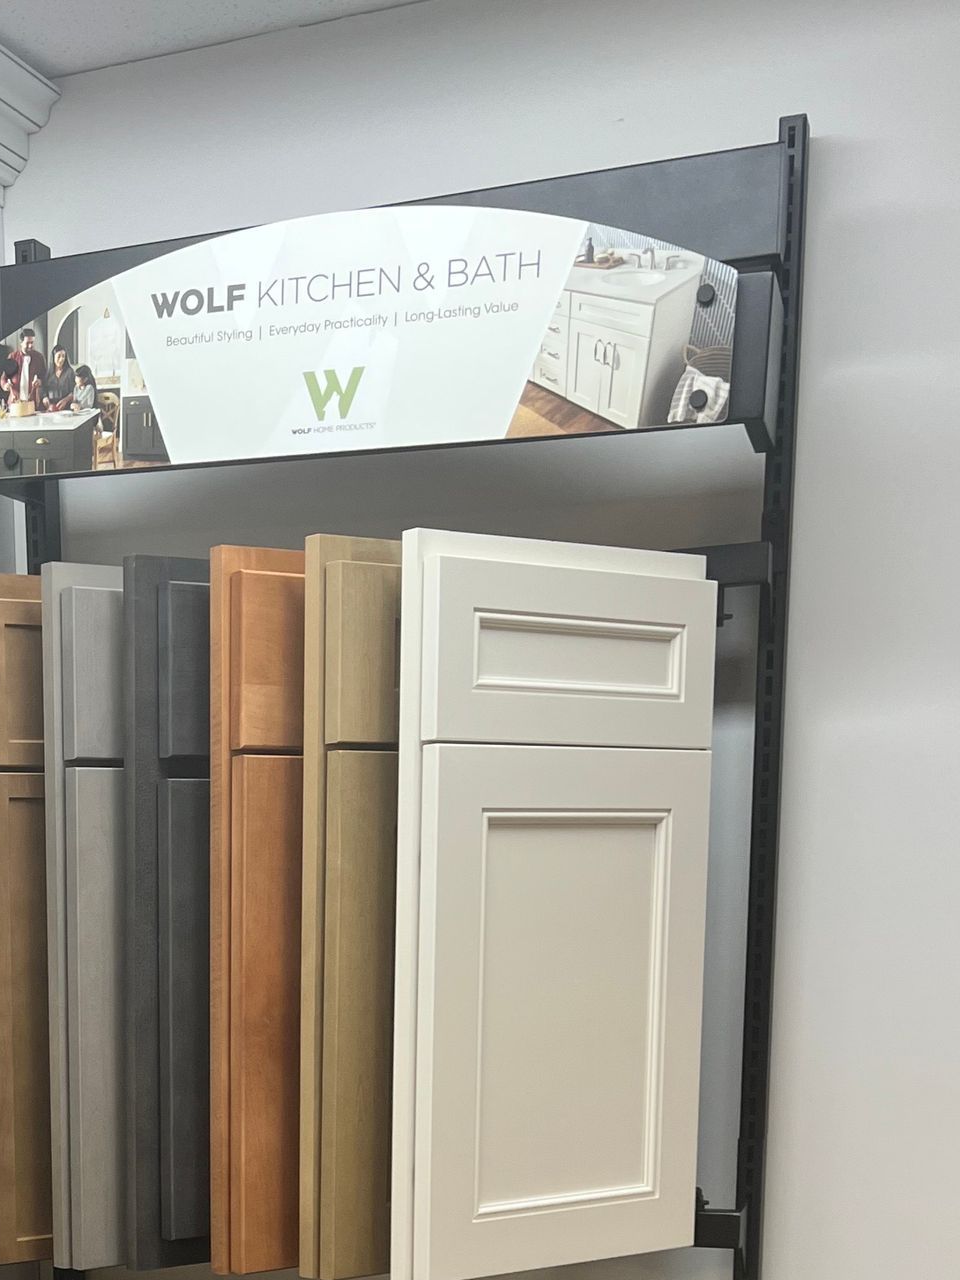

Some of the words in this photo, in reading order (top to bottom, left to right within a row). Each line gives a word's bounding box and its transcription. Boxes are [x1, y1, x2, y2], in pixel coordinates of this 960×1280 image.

[151, 284, 246, 319] WOLF
[258, 265, 401, 308] KITCHEN
[413, 262, 435, 291] &
[447, 250, 541, 288] BATH
[166, 331, 214, 347] Beautiful
[216, 328, 253, 342] Styling
[269, 321, 321, 338] Everyday
[324, 314, 388, 331] Practicality
[405, 304, 481, 323] Long-Lasting
[484, 301, 519, 315] Value
[302, 366, 365, 421] W
[291, 427, 312, 435] WOLF
[313, 425, 334, 434] HOME
